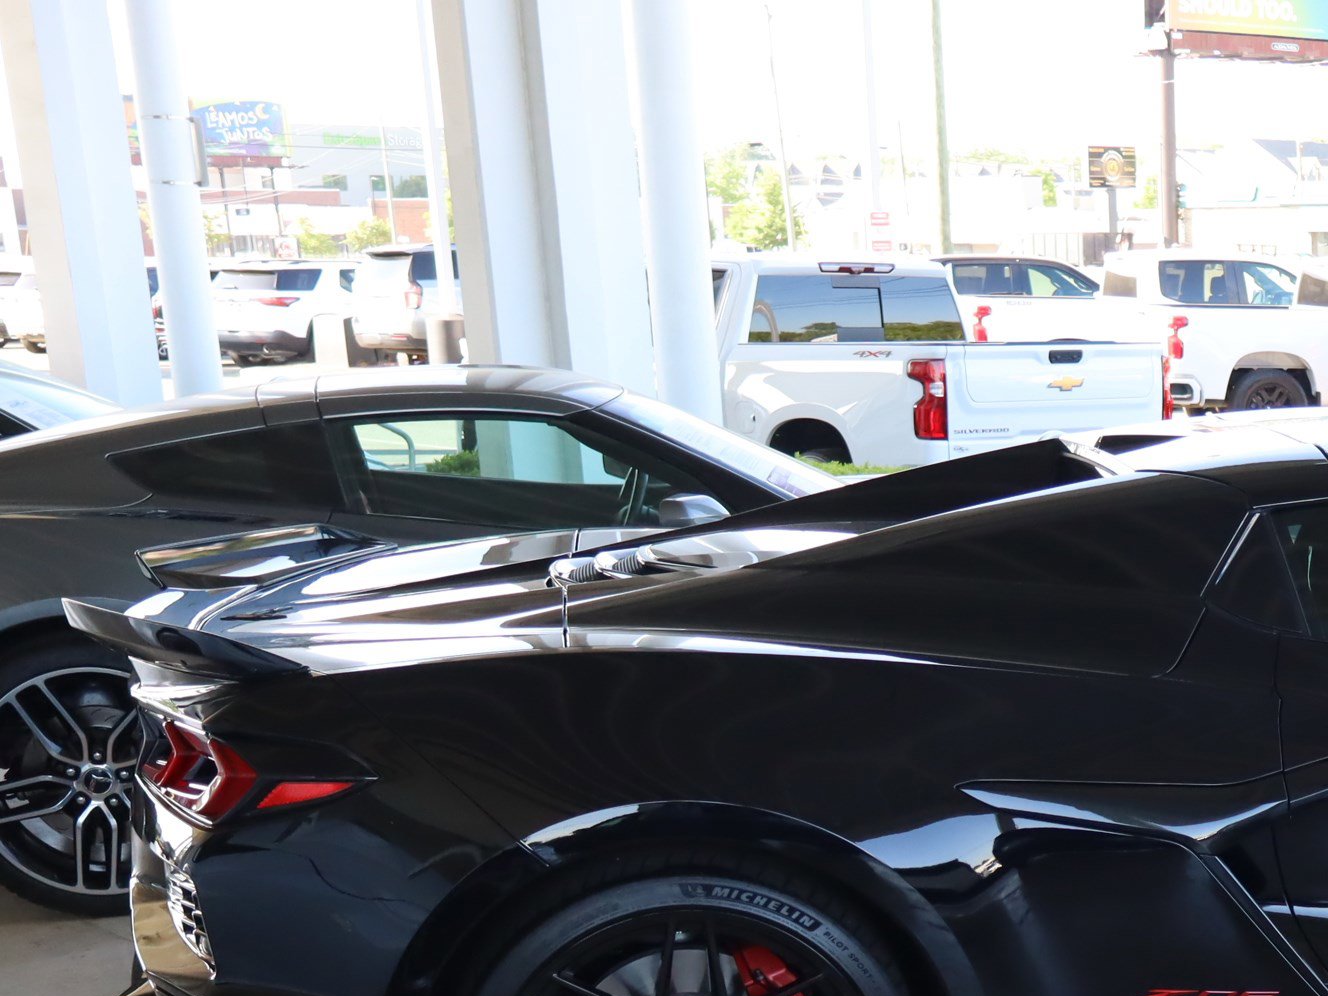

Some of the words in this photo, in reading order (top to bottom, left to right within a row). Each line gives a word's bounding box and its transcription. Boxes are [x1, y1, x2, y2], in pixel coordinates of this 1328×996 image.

[953, 427, 1010, 435] SILVERADO
[711, 886, 816, 928] MICHELIN
[823, 931, 849, 952] PILOT
[848, 952, 874, 979] SPORT
